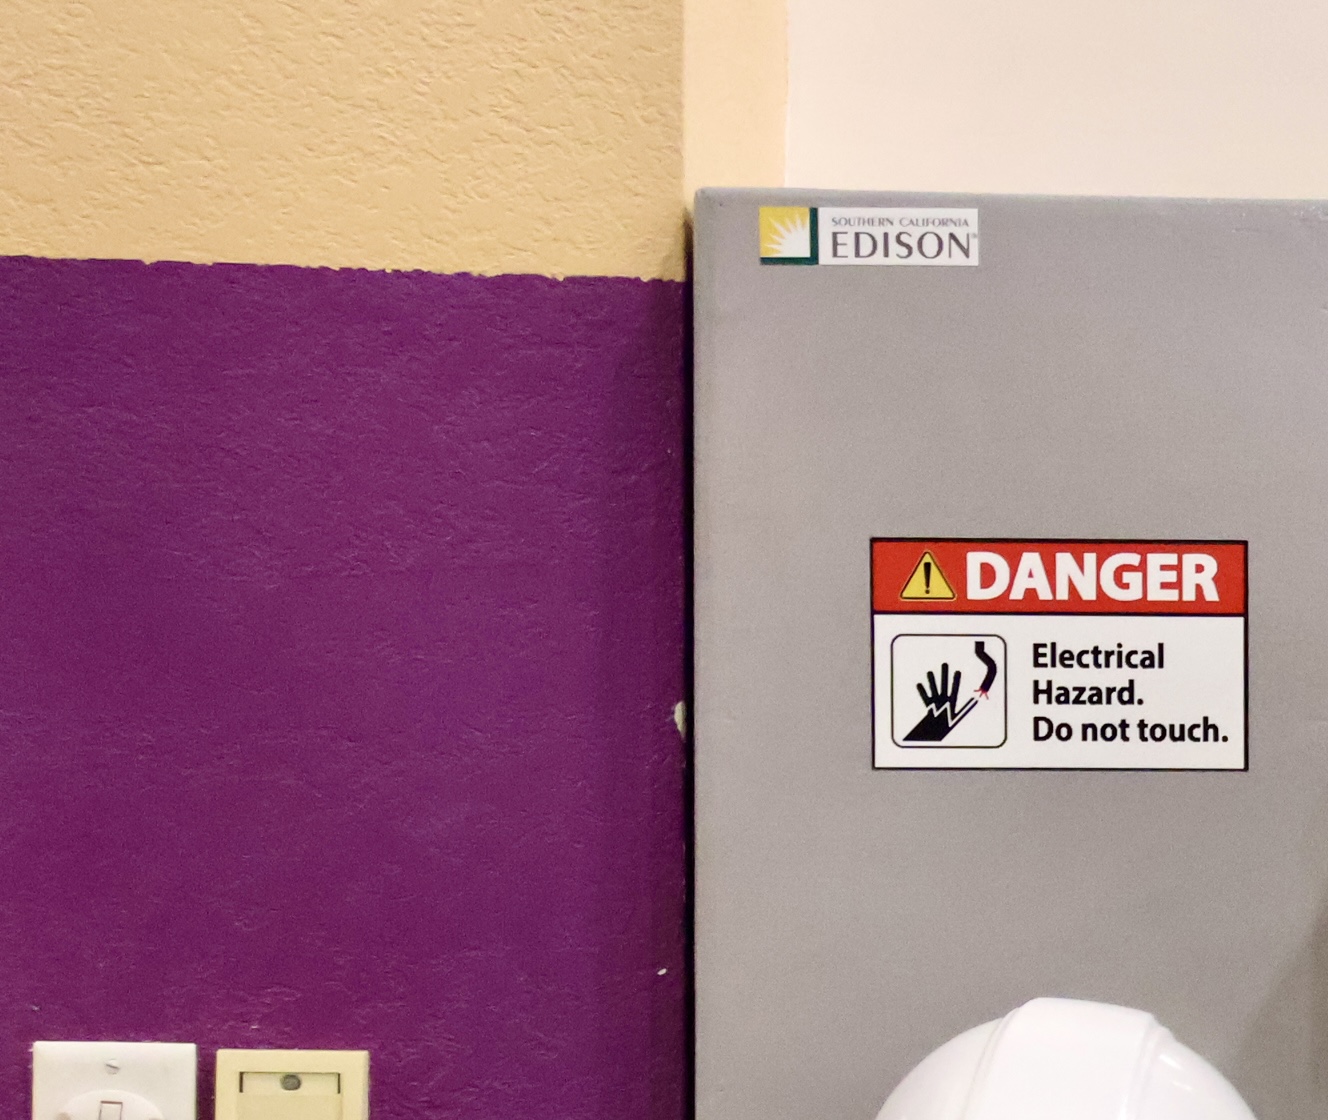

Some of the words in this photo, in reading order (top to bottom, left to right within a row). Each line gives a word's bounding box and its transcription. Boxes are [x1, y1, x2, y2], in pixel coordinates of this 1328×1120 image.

[831, 216, 894, 228] SOUTHERN
[899, 216, 970, 228] CALIFORNIA
[831, 231, 971, 260] EDISON
[966, 551, 1220, 602] DANGER
[1032, 642, 1165, 669] Electrical
[1032, 679, 1144, 706] Hazard.
[1032, 716, 1073, 743] Do
[1081, 719, 1130, 743] not
[1138, 715, 1229, 743] touch.
